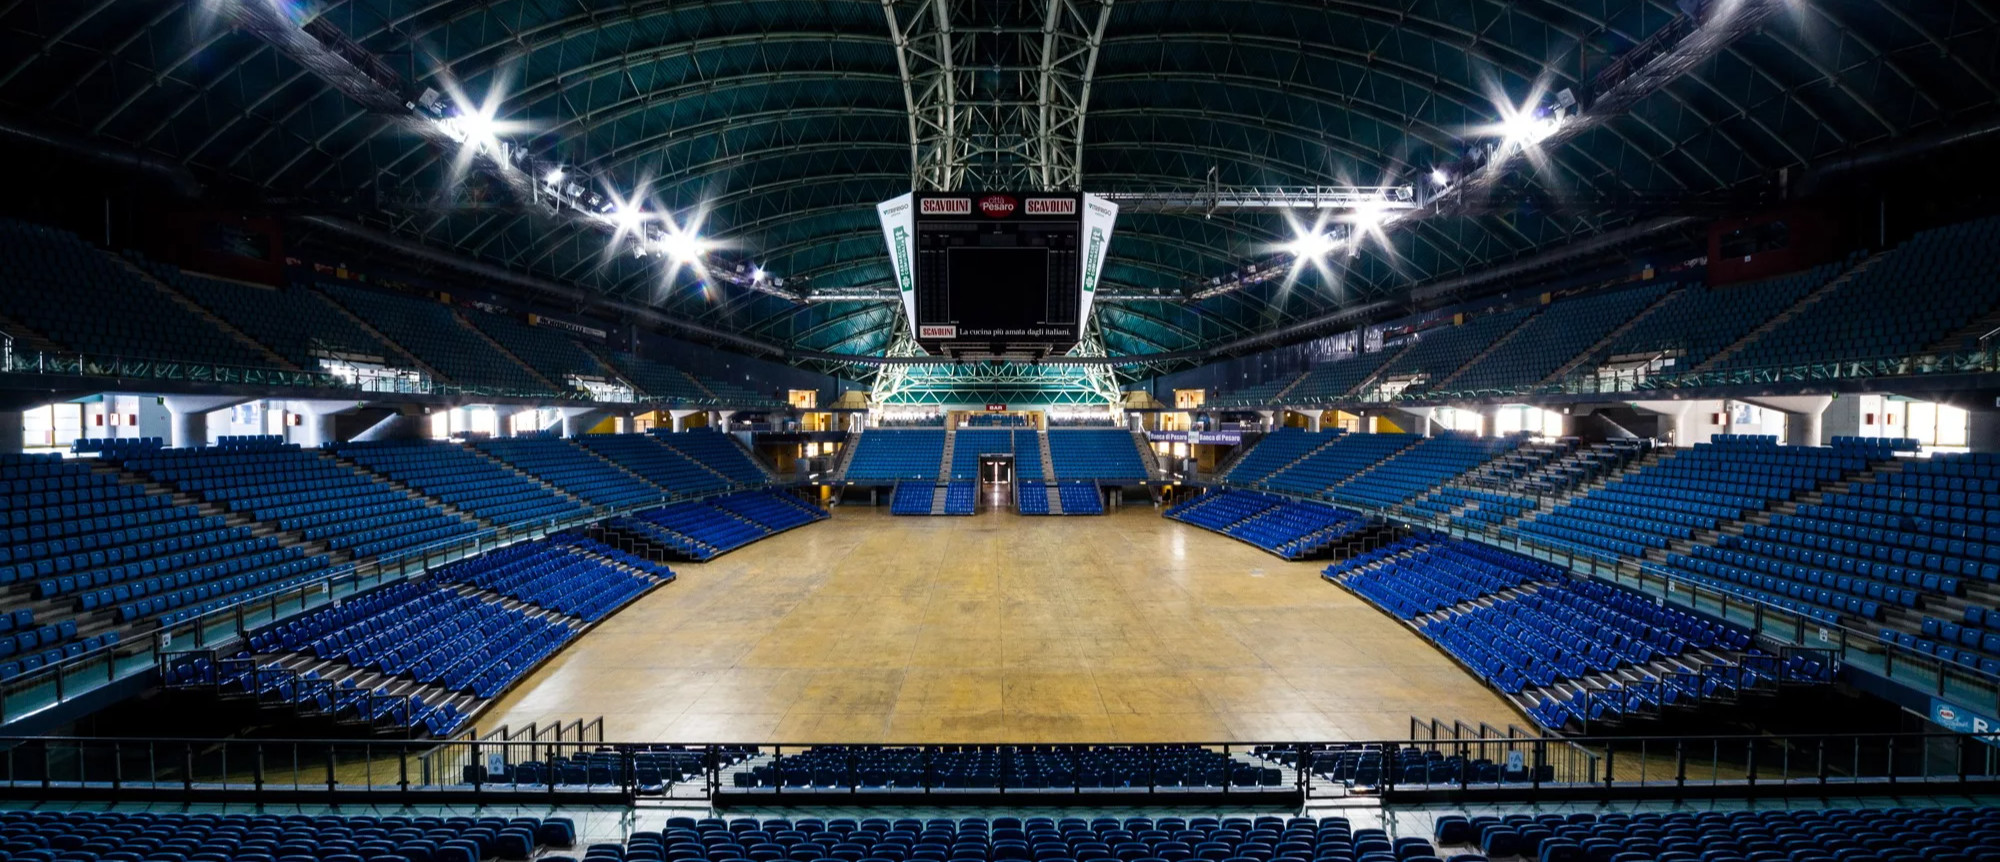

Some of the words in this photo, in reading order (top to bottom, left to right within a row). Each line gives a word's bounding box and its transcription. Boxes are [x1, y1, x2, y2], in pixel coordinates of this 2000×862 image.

[923, 200, 968, 212] SCAVOLINI
[983, 202, 1014, 212] Pesaro
[1028, 200, 1073, 212] SCAVOLINI
[923, 327, 953, 336] SCAVOLINI
[1027, 328, 1044, 337] dagli
